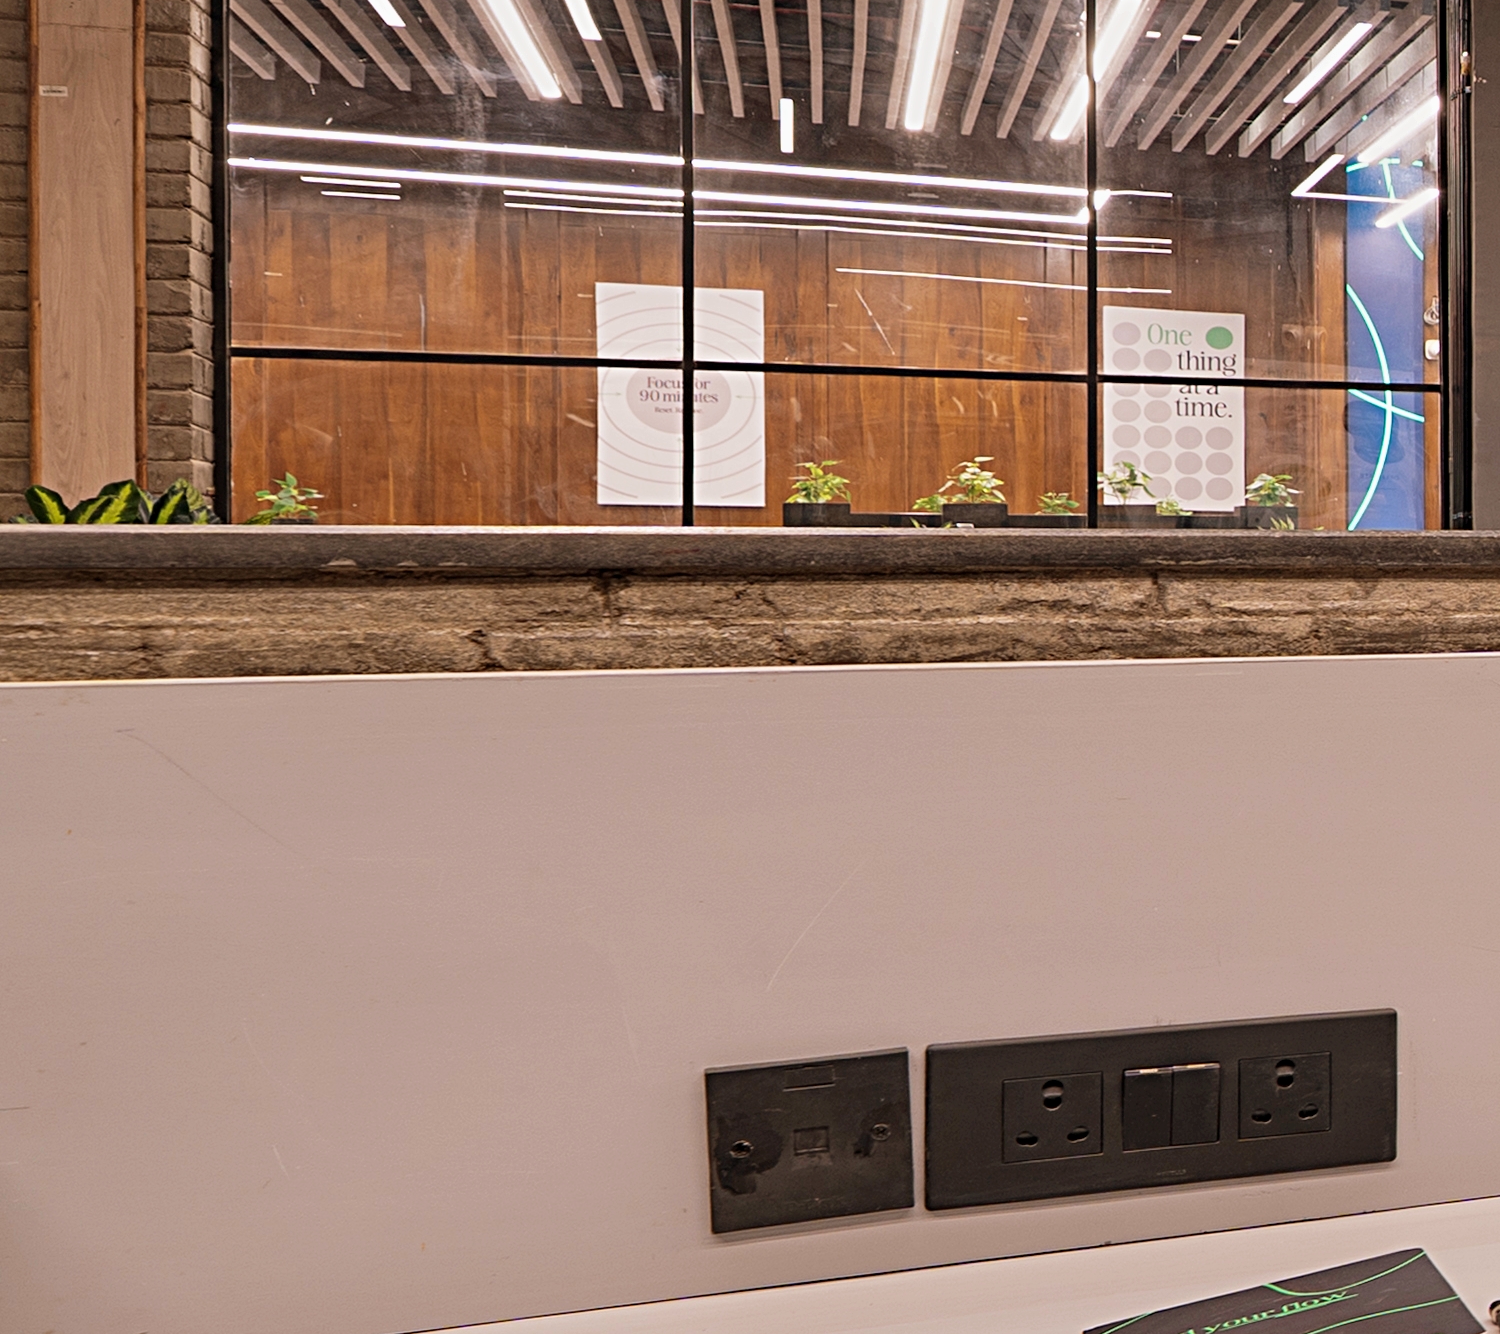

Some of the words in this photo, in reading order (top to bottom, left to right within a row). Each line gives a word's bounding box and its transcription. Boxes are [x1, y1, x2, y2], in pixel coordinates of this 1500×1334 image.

[1147, 323, 1192, 345] One
[1176, 350, 1236, 376] thing
[647, 376, 682, 389] Focu
[639, 390, 660, 402] 90
[1175, 397, 1233, 418] time.
[1203, 1308, 1276, 1334] your
[1281, 1291, 1350, 1319] flow
